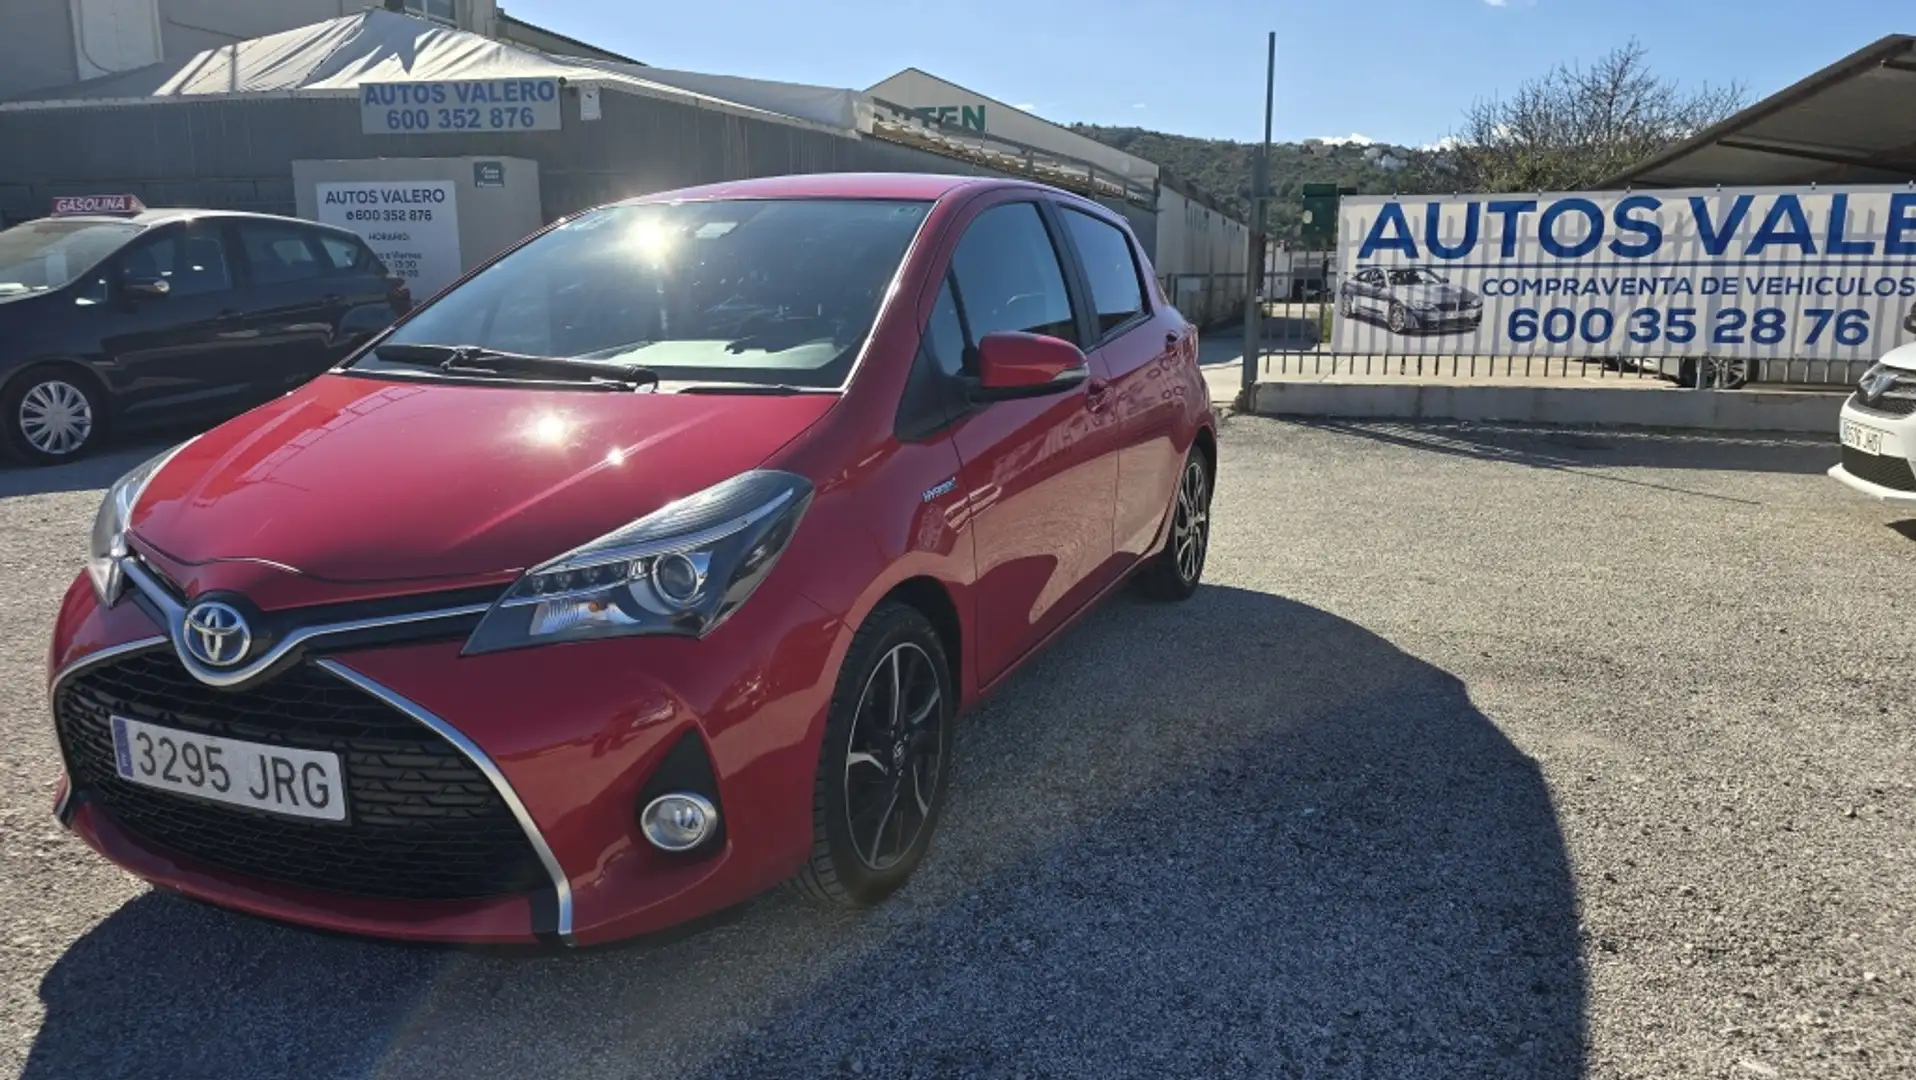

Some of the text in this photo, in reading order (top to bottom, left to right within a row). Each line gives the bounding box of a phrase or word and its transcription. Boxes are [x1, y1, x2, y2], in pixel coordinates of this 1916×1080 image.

[364, 80, 555, 106] AUTOS VALERO
[386, 106, 535, 130] 600 352 876
[56, 196, 125, 213] GASOLINA
[325, 188, 445, 205] AUTOS VALERO
[382, 209, 406, 222] 352
[1357, 193, 1662, 259] AUTOS
[1482, 275, 1915, 297] COMPRAVENTA DE VEHICULOS
[1508, 306, 1870, 345] 600 35 28 76
[136, 731, 330, 809] 3295 JRG
